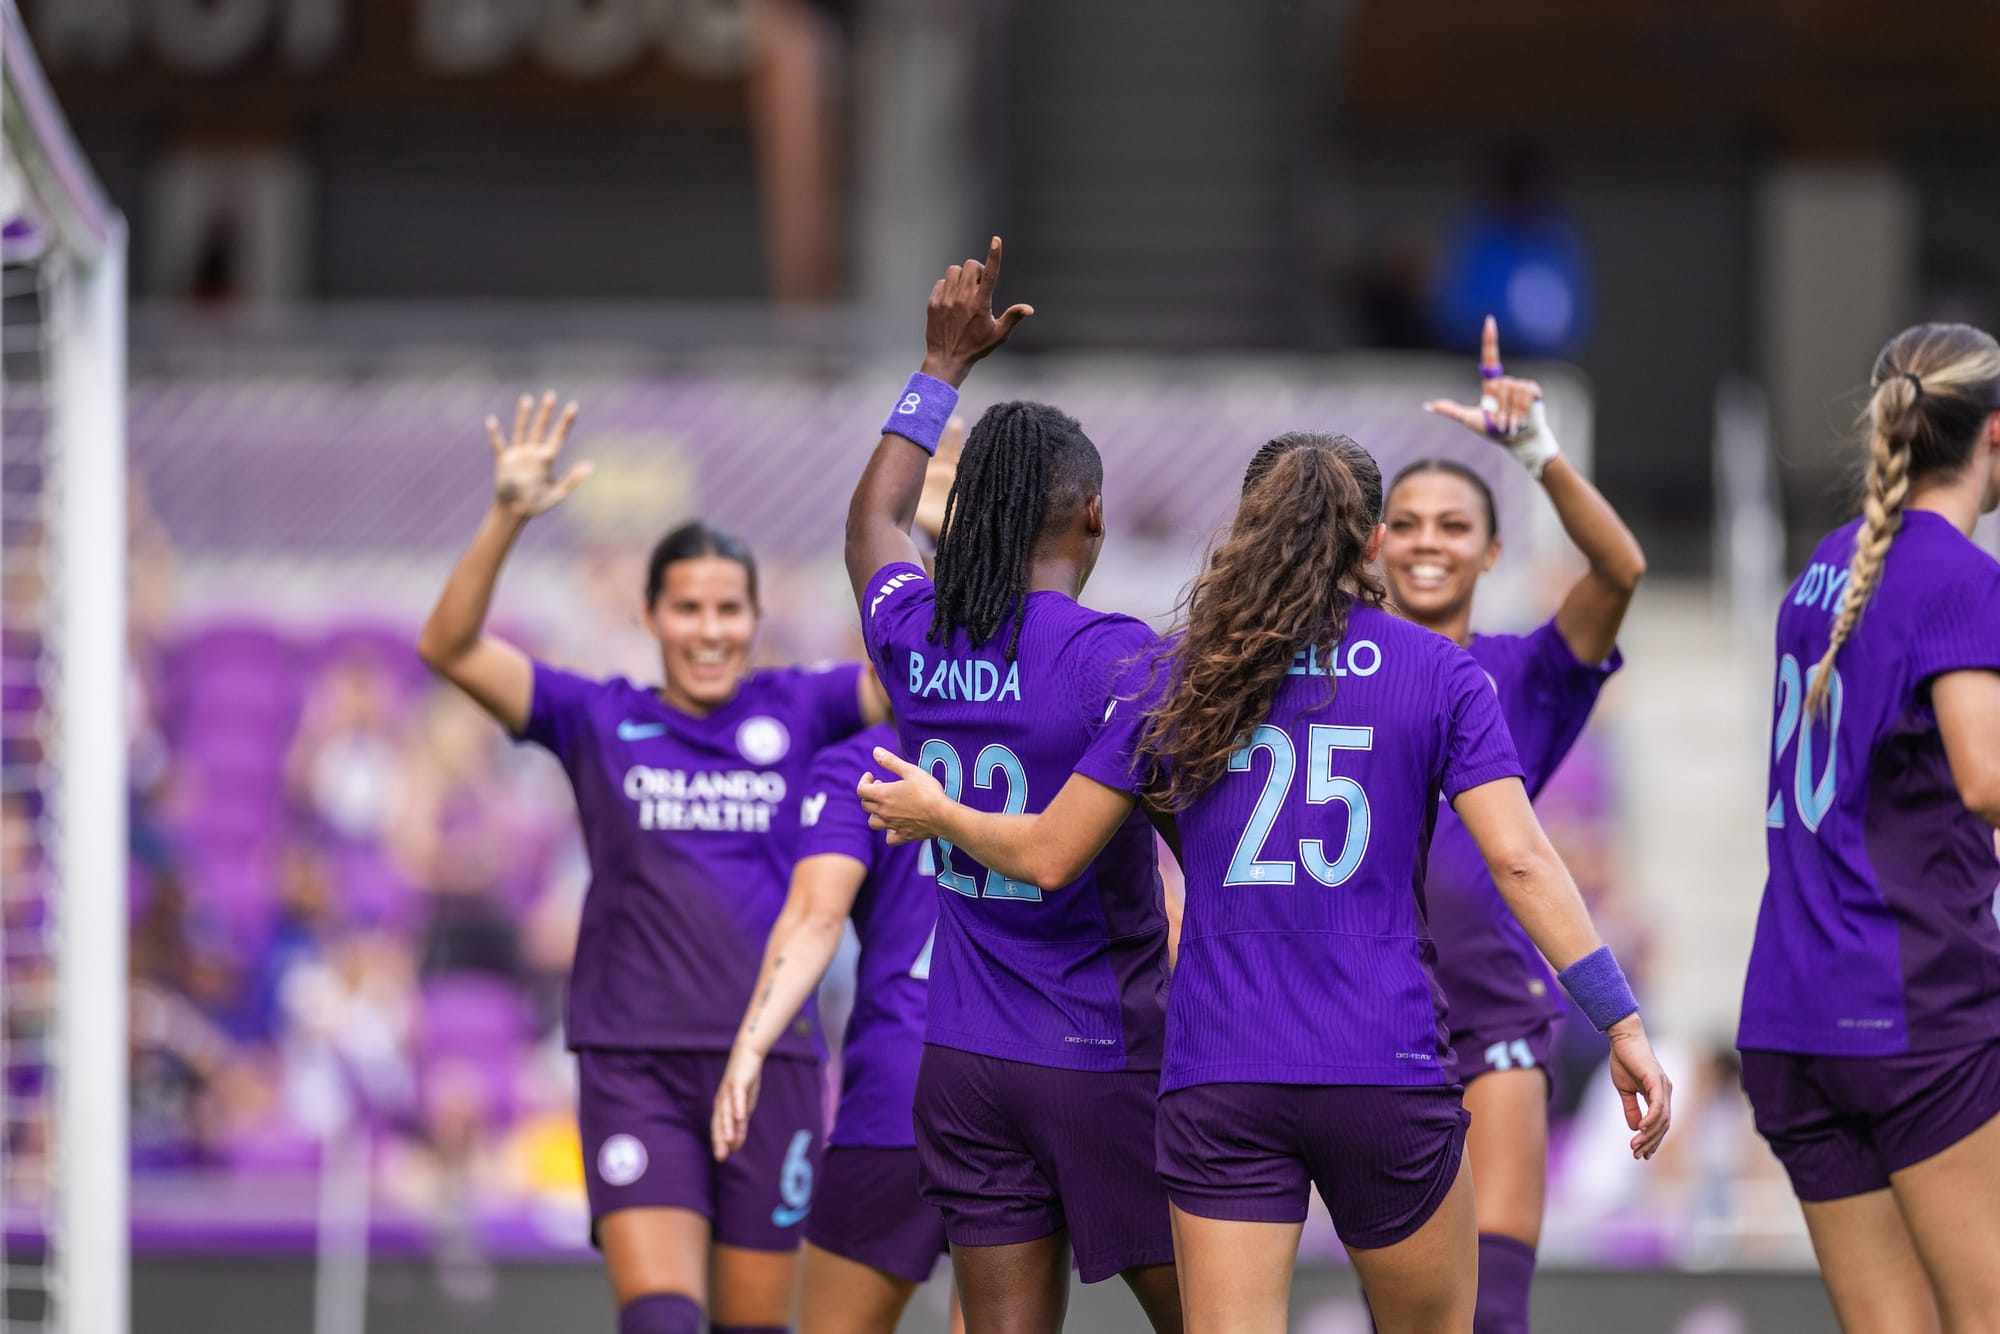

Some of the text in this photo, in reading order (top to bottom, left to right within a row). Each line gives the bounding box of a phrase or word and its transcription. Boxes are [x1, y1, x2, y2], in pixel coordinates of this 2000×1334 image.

[899, 393, 920, 414] 8
[909, 650, 1022, 702] BANDA
[1766, 653, 1843, 834] 20
[623, 765, 787, 804] ORLANDO
[1223, 724, 1374, 887] 25
[638, 799, 771, 833] HEALTH
[918, 738, 1043, 902] 22
[1485, 1038, 1536, 1071] 11
[779, 1128, 814, 1210] 6
